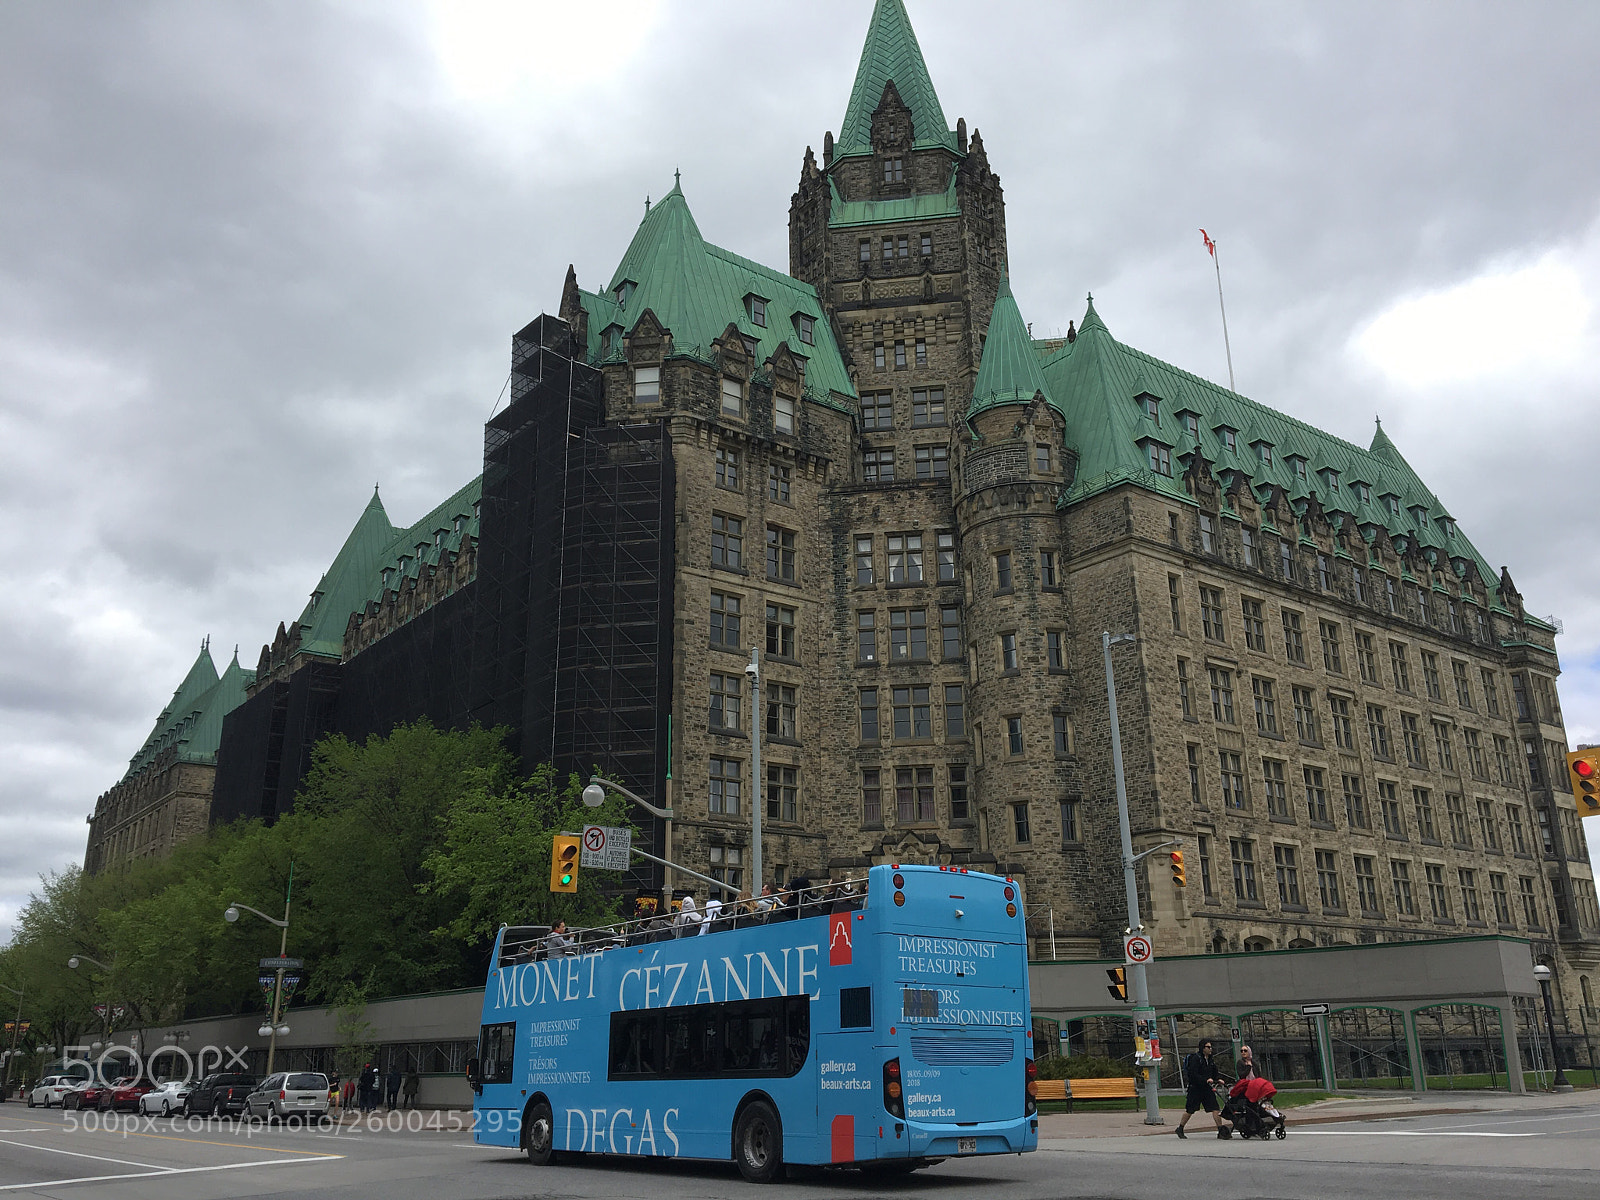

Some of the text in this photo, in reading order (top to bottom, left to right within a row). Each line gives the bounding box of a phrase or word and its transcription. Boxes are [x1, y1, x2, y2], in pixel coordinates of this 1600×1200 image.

[898, 937, 998, 958] IMPRESSIONIST
[898, 956, 977, 975] TREASURES
[494, 944, 821, 1012] MONET CÉZANNE
[531, 1018, 581, 1034] IMPRESSIONIST
[530, 1034, 568, 1047] TREASURES
[529, 1055, 557, 1070] TRÉSORS
[820, 1060, 856, 1075] gallery.ca
[527, 1071, 591, 1084] IMPRESSIONNISTES
[821, 1078, 871, 1090] beaux-arts.ca
[907, 1079, 920, 1087] 2018
[907, 1093, 942, 1105] gallery.ca
[908, 1107, 956, 1117] beaux-arts.ca
[565, 1108, 680, 1157] DEGAS
